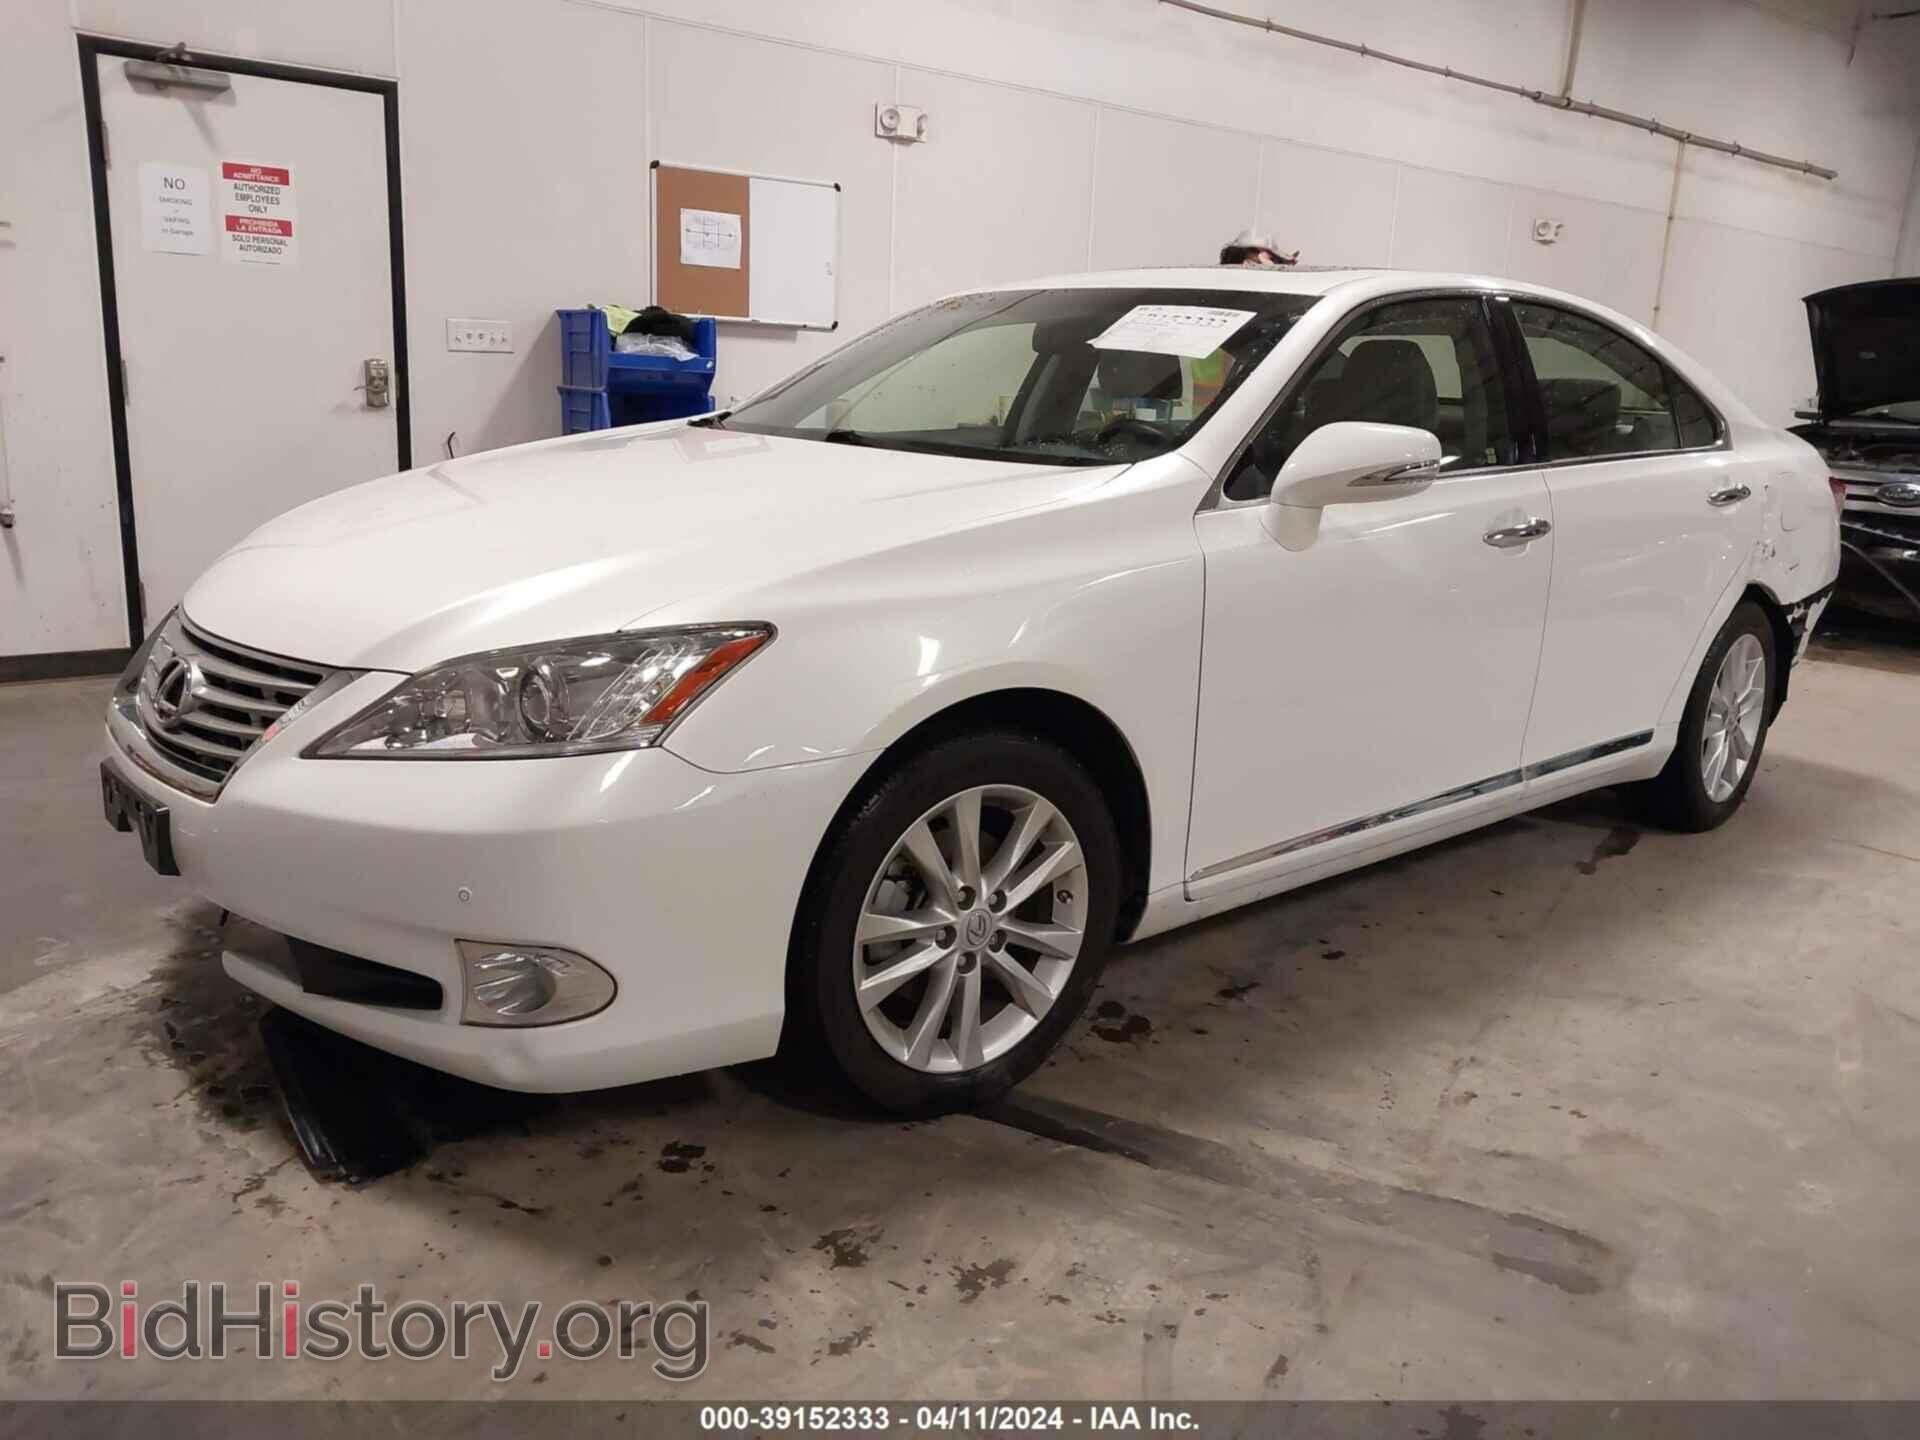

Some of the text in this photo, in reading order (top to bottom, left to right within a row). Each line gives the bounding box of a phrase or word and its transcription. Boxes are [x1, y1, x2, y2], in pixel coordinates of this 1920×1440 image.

[163, 177, 185, 190] NO
[233, 172, 279, 183] ADMITTANCE
[233, 183, 280, 195] AUTHORIZED
[235, 193, 280, 205] EMPLOYEES
[248, 204, 268, 214] ONLY
[247, 225, 282, 235] ENTRADA
[231, 234, 288, 247] SOLO PERSONAL
[238, 243, 282, 255] AUTORIZADO
